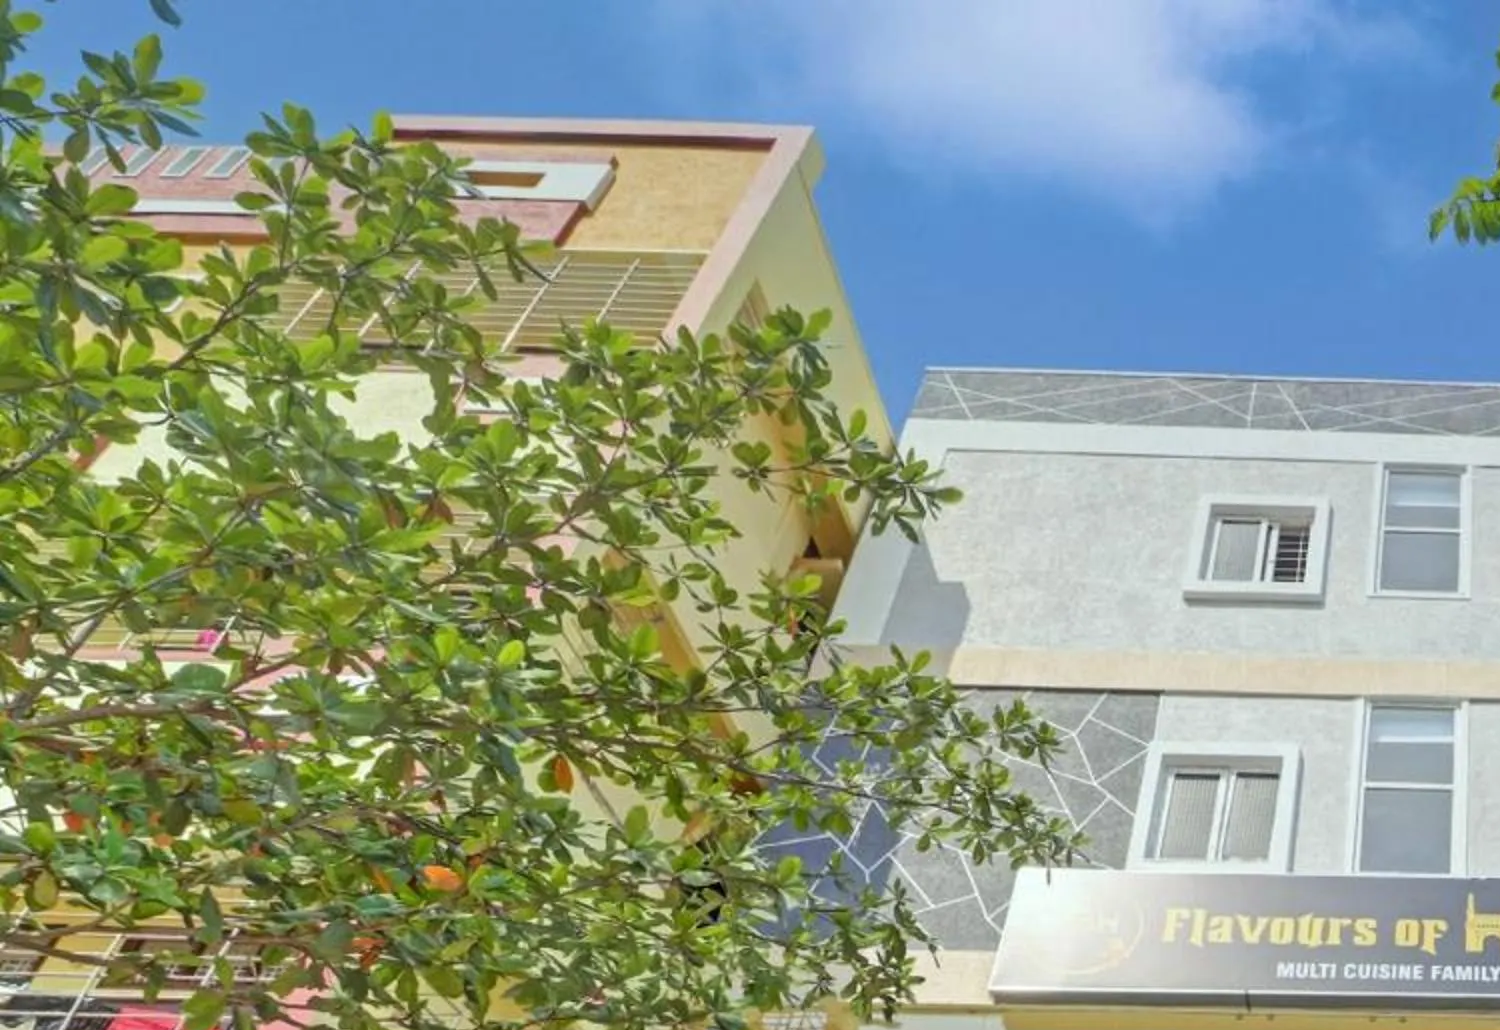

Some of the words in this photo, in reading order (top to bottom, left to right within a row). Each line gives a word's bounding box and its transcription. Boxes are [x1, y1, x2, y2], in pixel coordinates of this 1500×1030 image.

[1161, 906, 1378, 949] Flavours
[1275, 960, 1337, 980] MULTI
[1343, 962, 1424, 981] CUISINE
